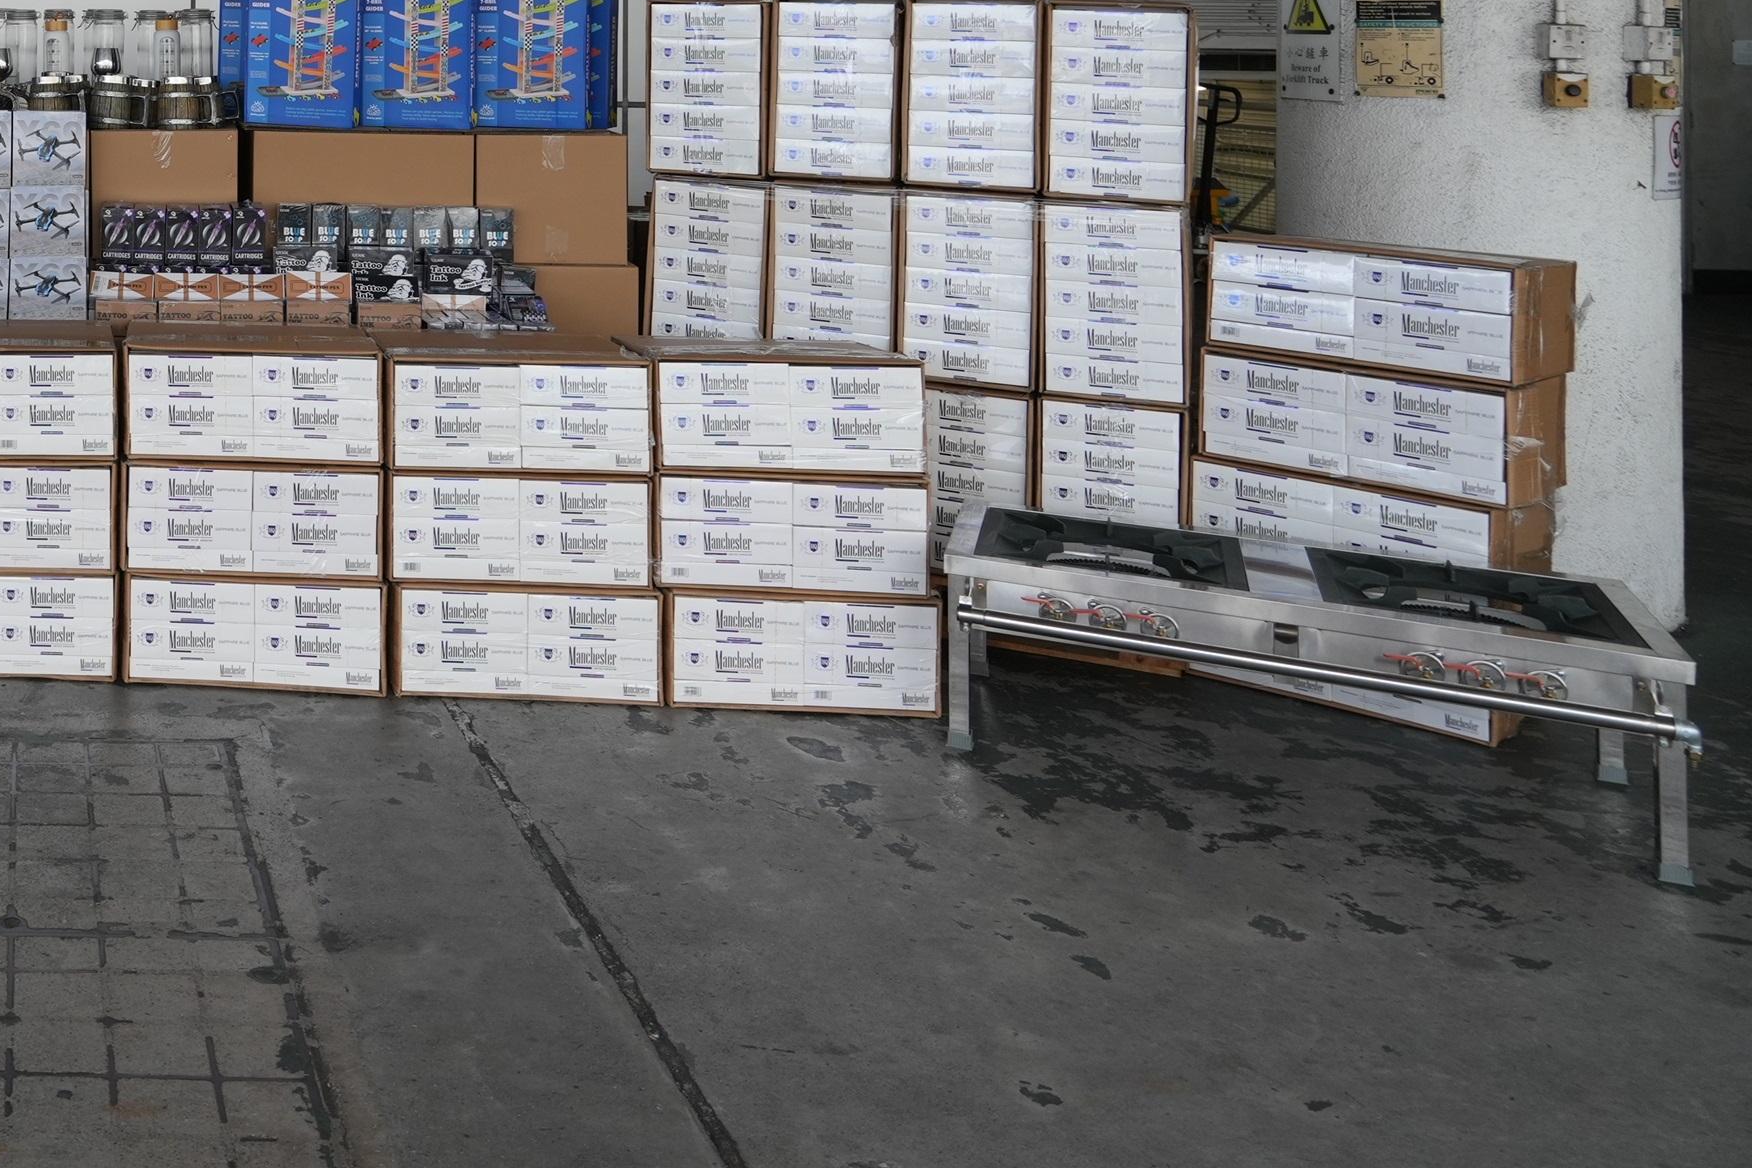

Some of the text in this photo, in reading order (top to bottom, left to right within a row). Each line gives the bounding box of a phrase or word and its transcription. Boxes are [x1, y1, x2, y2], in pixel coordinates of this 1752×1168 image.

[684, 10, 725, 27] Manchester
[683, 75, 724, 95] Manchester
[1308, 76, 1328, 84] Truck
[688, 190, 730, 210] Manchester
[284, 227, 305, 236] BLUE
[318, 227, 339, 235] BLUE
[353, 229, 374, 237] BLUE
[487, 232, 508, 240] BLUE
[201, 253, 229, 261] CARTRIDGES
[351, 261, 383, 269] Tattoo
[430, 265, 462, 274] Tattoo
[356, 284, 387, 292] Tattoo
[1400, 268, 1459, 296] Manchester
[1086, 325, 1138, 350] Manchester
[30, 365, 75, 382] Manchester
[168, 365, 213, 382] Manchester
[701, 372, 749, 390] Manchester
[1088, 363, 1140, 388] Manchester
[1247, 368, 1299, 393] Manchester
[435, 374, 481, 394] Manchester
[832, 377, 880, 395] Manchester
[938, 398, 987, 420] Manchester
[1393, 389, 1452, 417] Manchester
[434, 486, 480, 506] Manchester
[704, 490, 752, 508] Manchester
[168, 519, 213, 536] Manchester
[716, 608, 764, 629] Manchester
[30, 625, 75, 642] Manchester
[569, 645, 617, 666] Manchester
